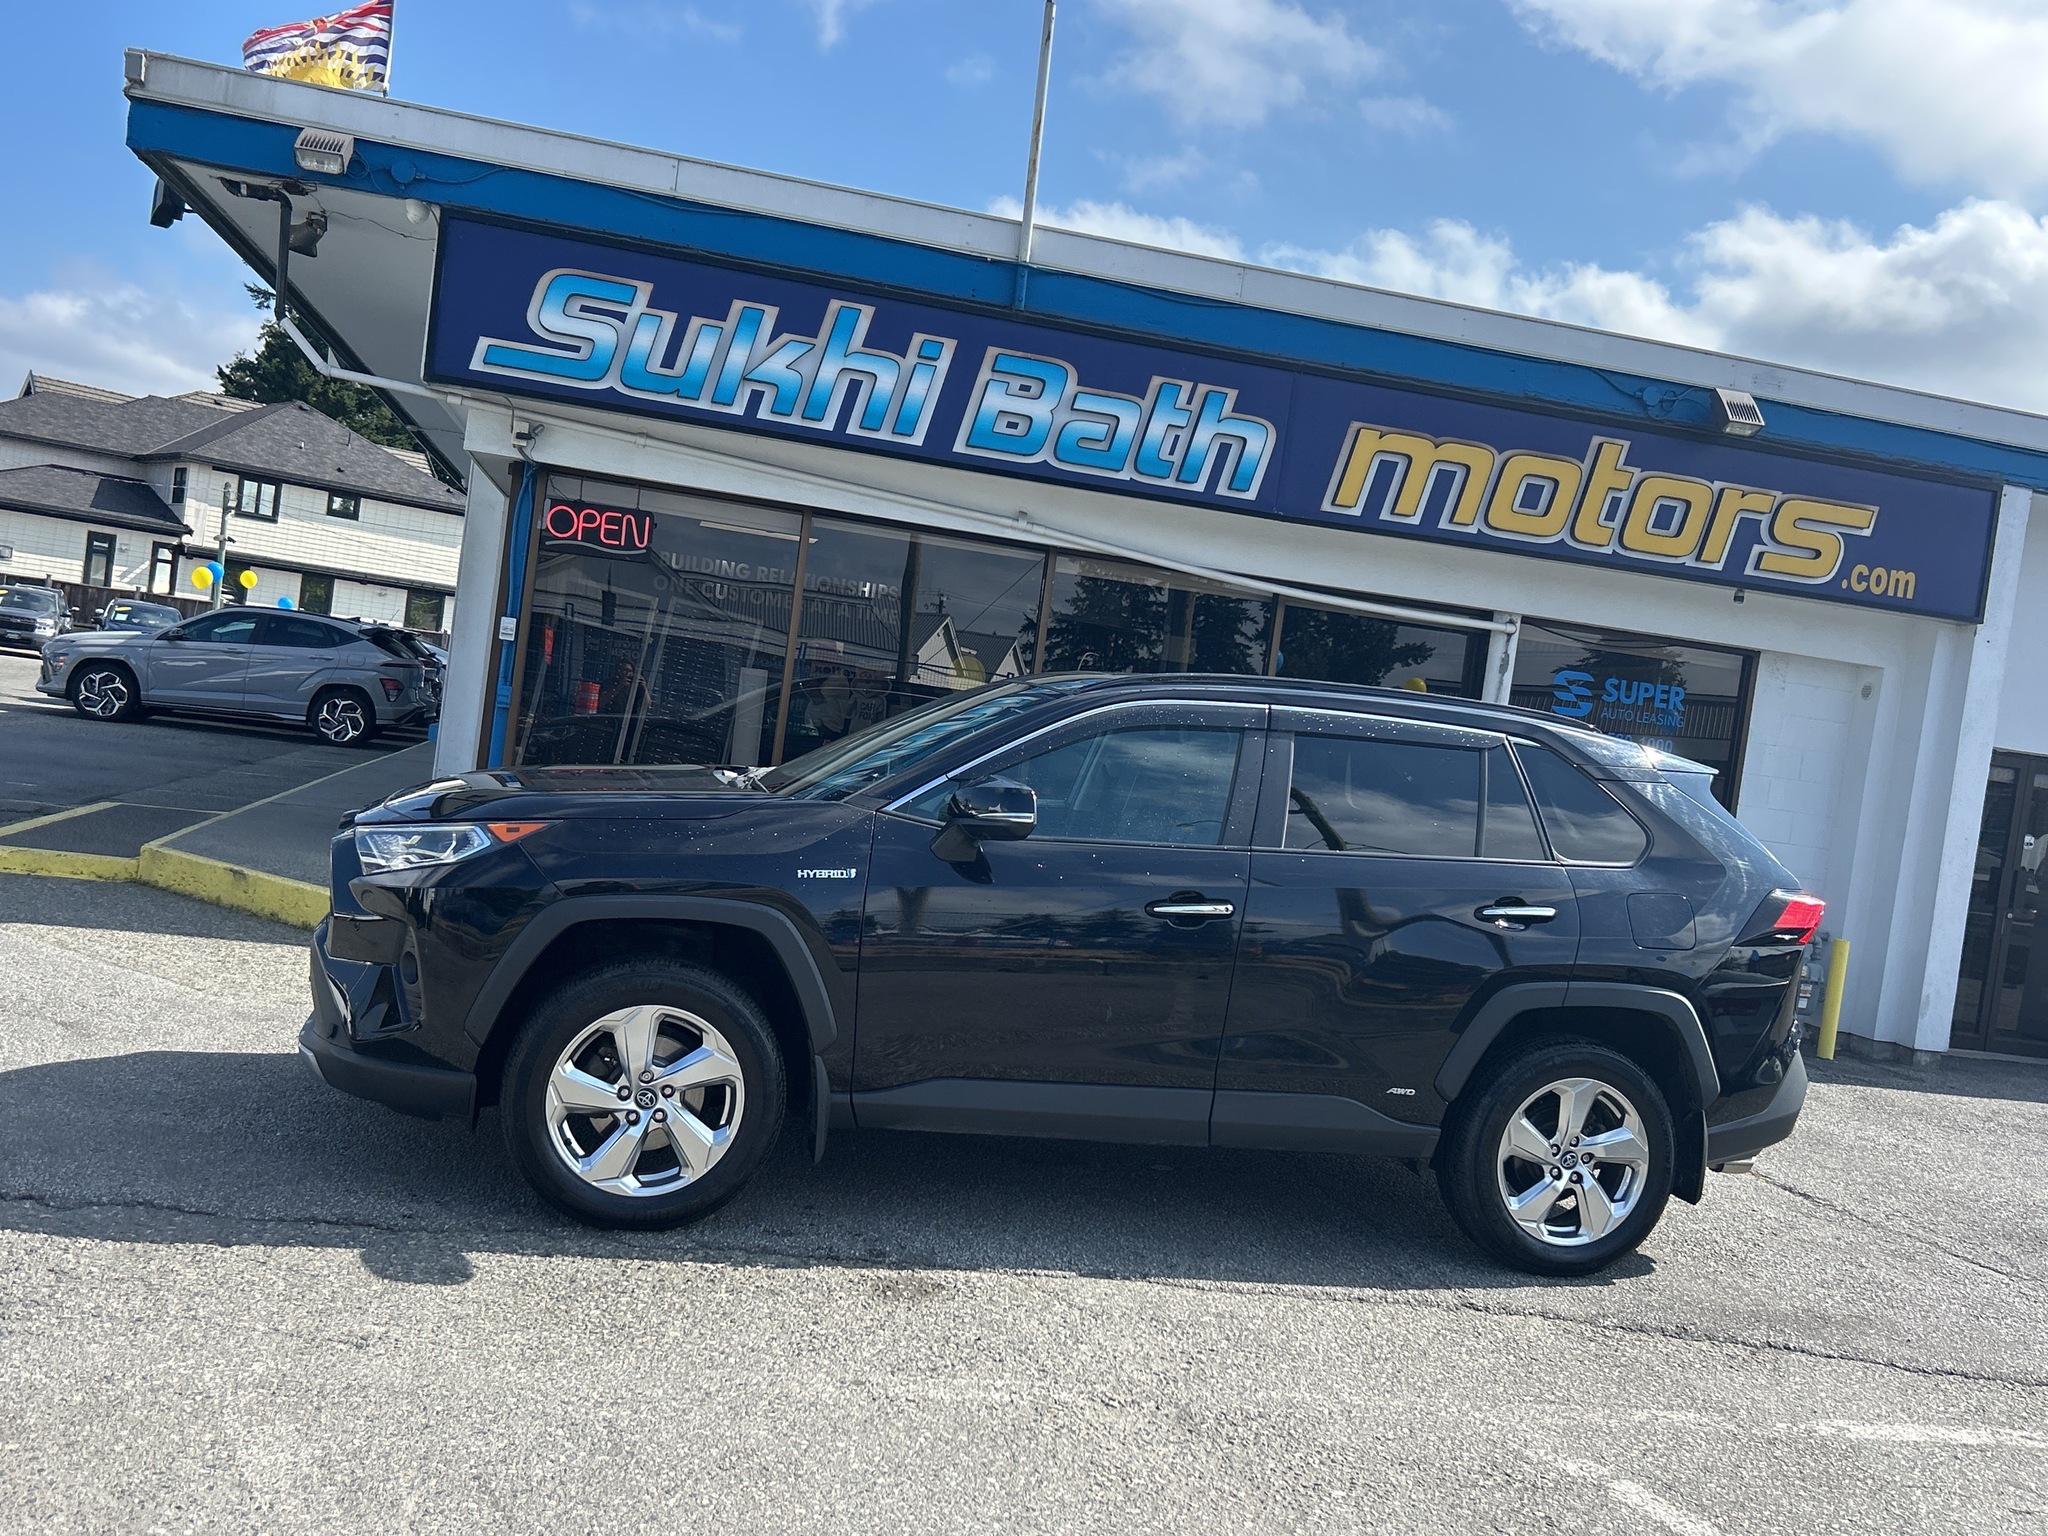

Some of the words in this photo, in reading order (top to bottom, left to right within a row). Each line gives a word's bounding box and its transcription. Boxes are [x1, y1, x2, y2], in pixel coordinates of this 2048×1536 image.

[469, 267, 958, 447] Sukhi
[953, 345, 1278, 501] Bath
[546, 505, 650, 549] OPEN
[660, 550, 751, 579] BUILDING
[702, 581, 804, 612] CUSTOME
[1601, 677, 1685, 711] SUPER
[1600, 707, 1633, 722] AUTO
[1636, 711, 1685, 728] LEASING
[796, 868, 848, 879] HYBRID
[1385, 1087, 1416, 1096] AWD
